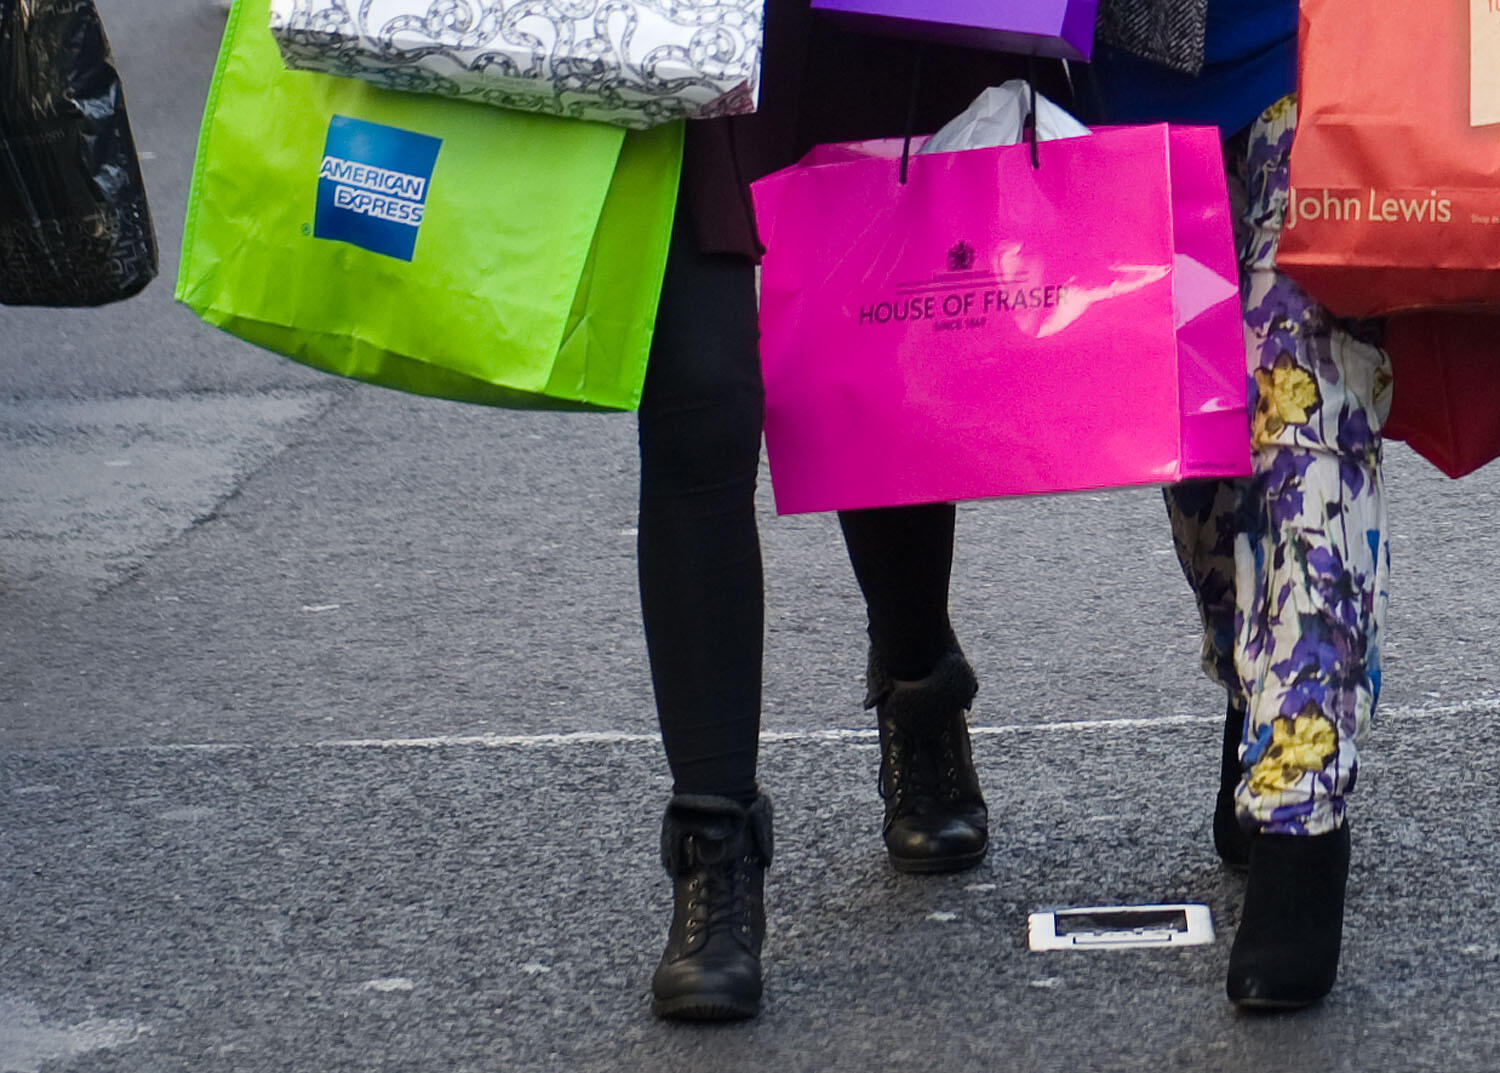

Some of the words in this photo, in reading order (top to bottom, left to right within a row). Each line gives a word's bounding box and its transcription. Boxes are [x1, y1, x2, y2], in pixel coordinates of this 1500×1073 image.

[319, 156, 425, 200] AMERICAN
[335, 185, 424, 227] EXPRESS
[1286, 186, 1361, 229] John
[1368, 187, 1451, 223] Lewis
[859, 296, 934, 326] HOUSE
[943, 293, 976, 316] OF
[984, 283, 1068, 313] FRASER
